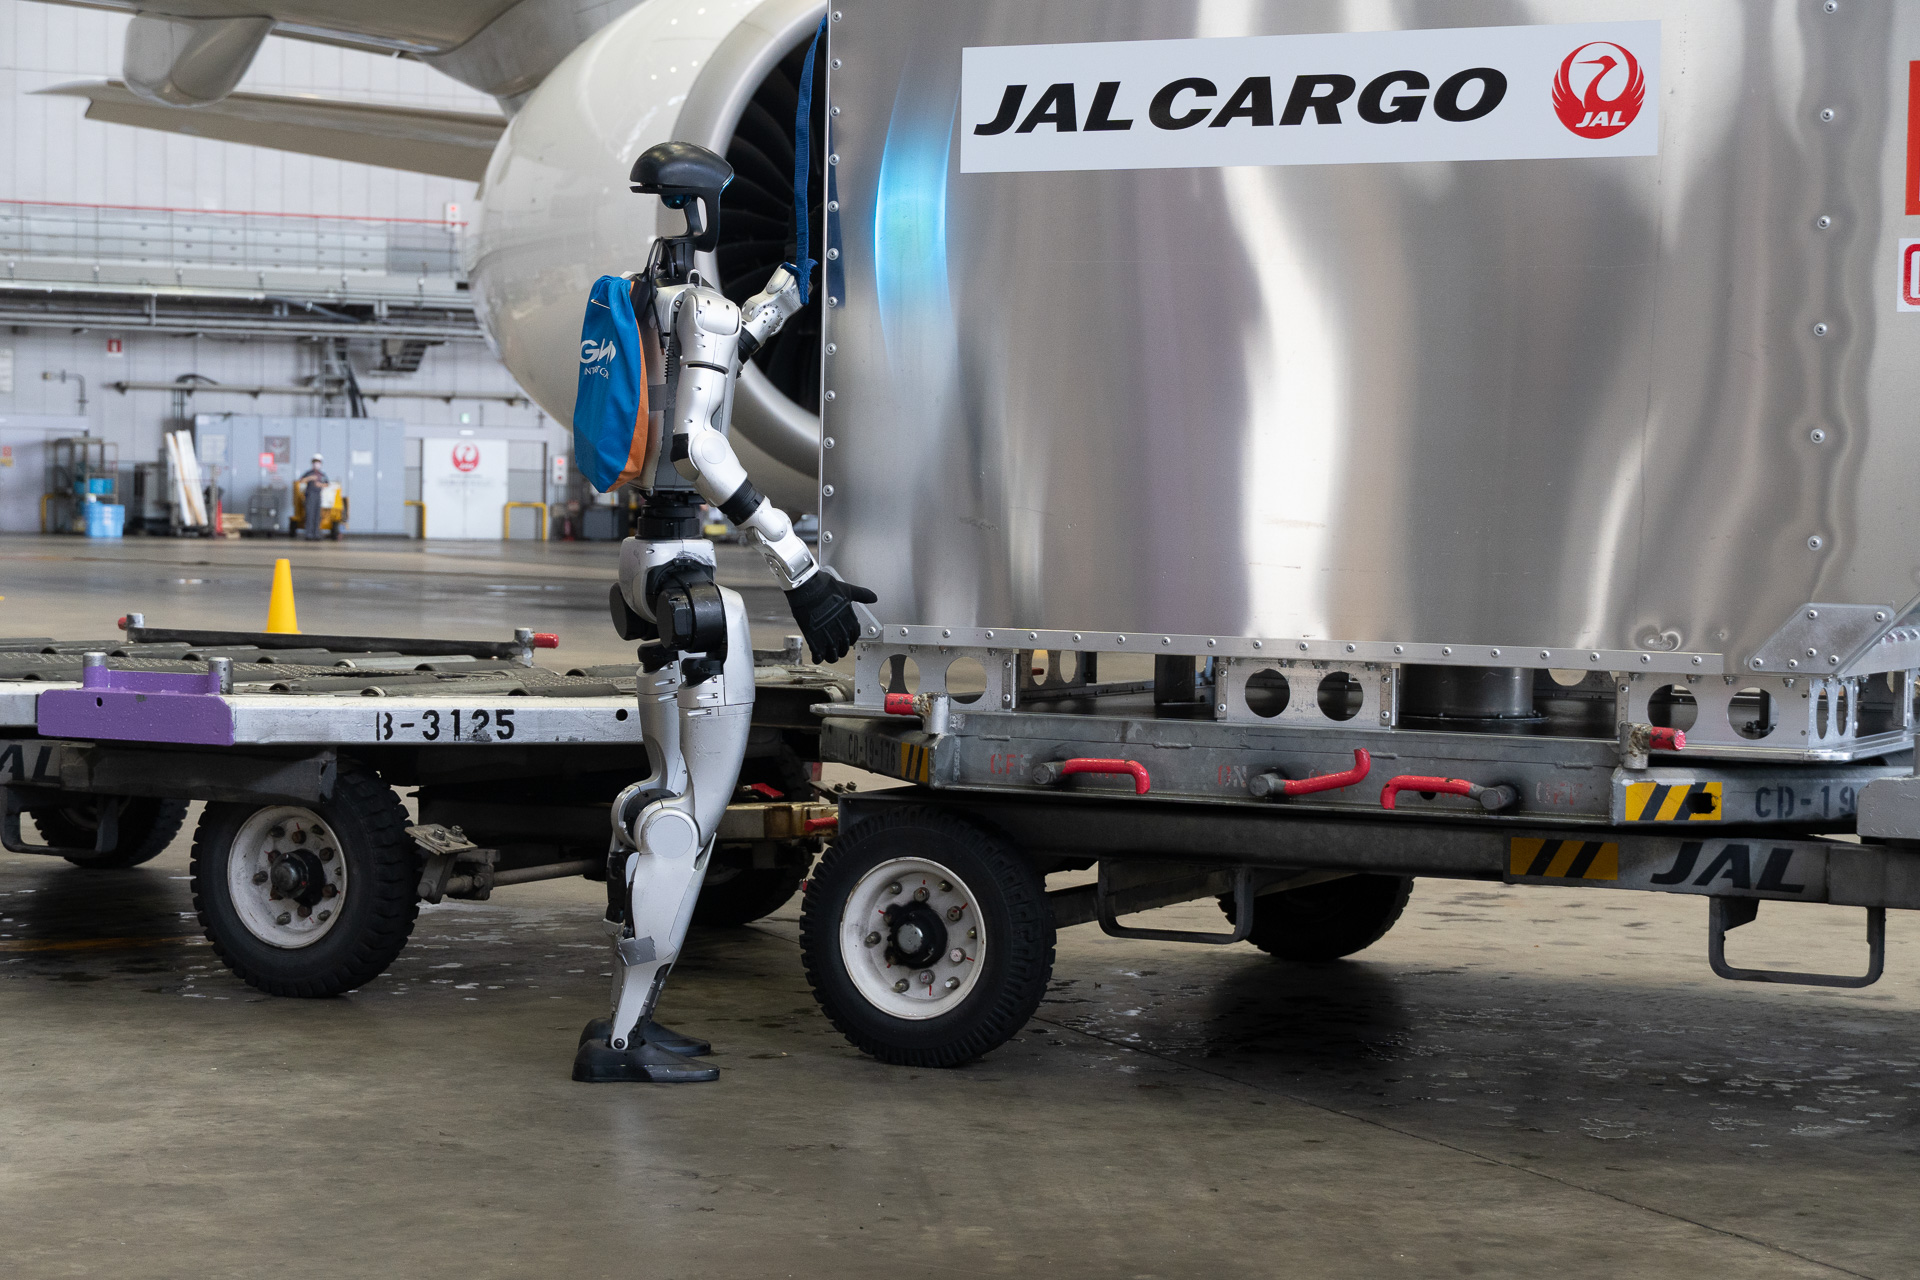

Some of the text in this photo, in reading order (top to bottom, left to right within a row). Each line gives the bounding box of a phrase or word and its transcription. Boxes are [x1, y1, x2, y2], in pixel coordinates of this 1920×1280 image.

[973, 67, 1508, 136] JAL CARGO
[1575, 110, 1626, 128] JAL
[376, 709, 516, 742] B-3125
[848, 733, 896, 772] CD-19-176
[1755, 785, 1856, 819] CD-19
[1650, 842, 1805, 893] JAL
